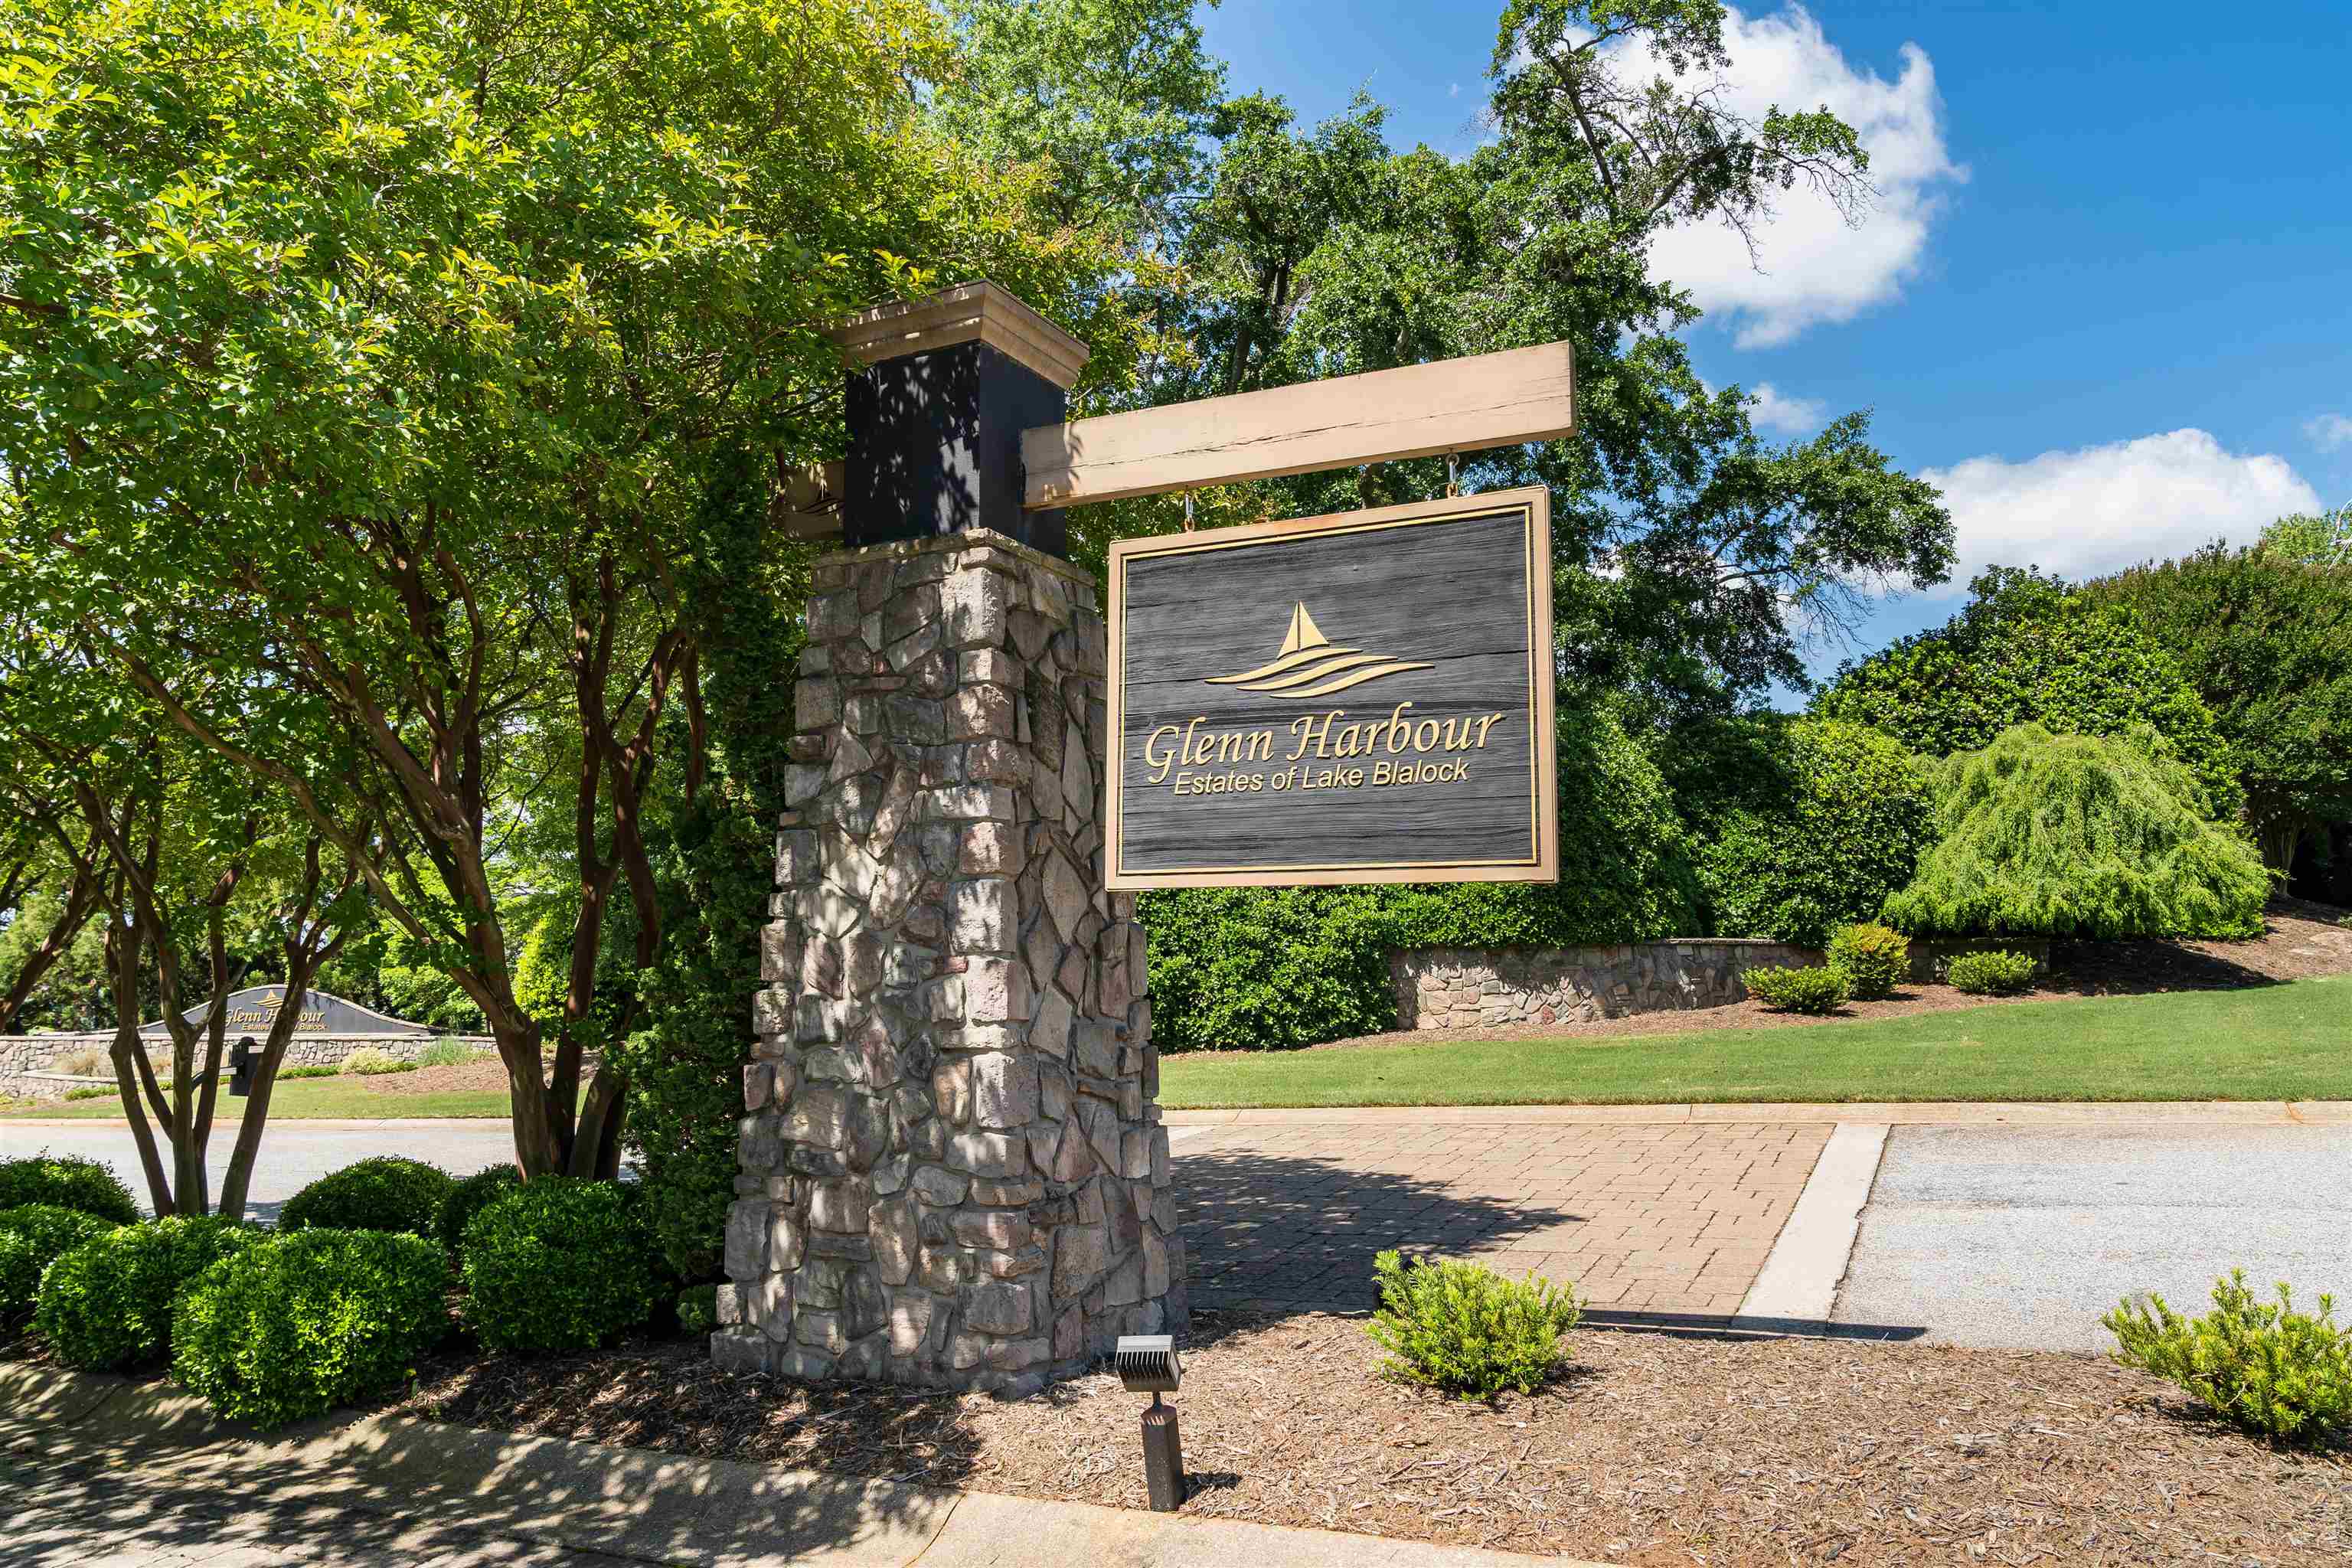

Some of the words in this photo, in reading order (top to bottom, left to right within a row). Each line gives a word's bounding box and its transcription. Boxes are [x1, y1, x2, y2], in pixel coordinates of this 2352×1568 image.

[1145, 717, 1274, 784] Glenn
[1286, 701, 1502, 761] Harbour
[1174, 771, 1264, 795] Estates
[1271, 766, 1298, 790] of
[1302, 764, 1364, 789] Lake
[1372, 757, 1469, 786] Blalock
